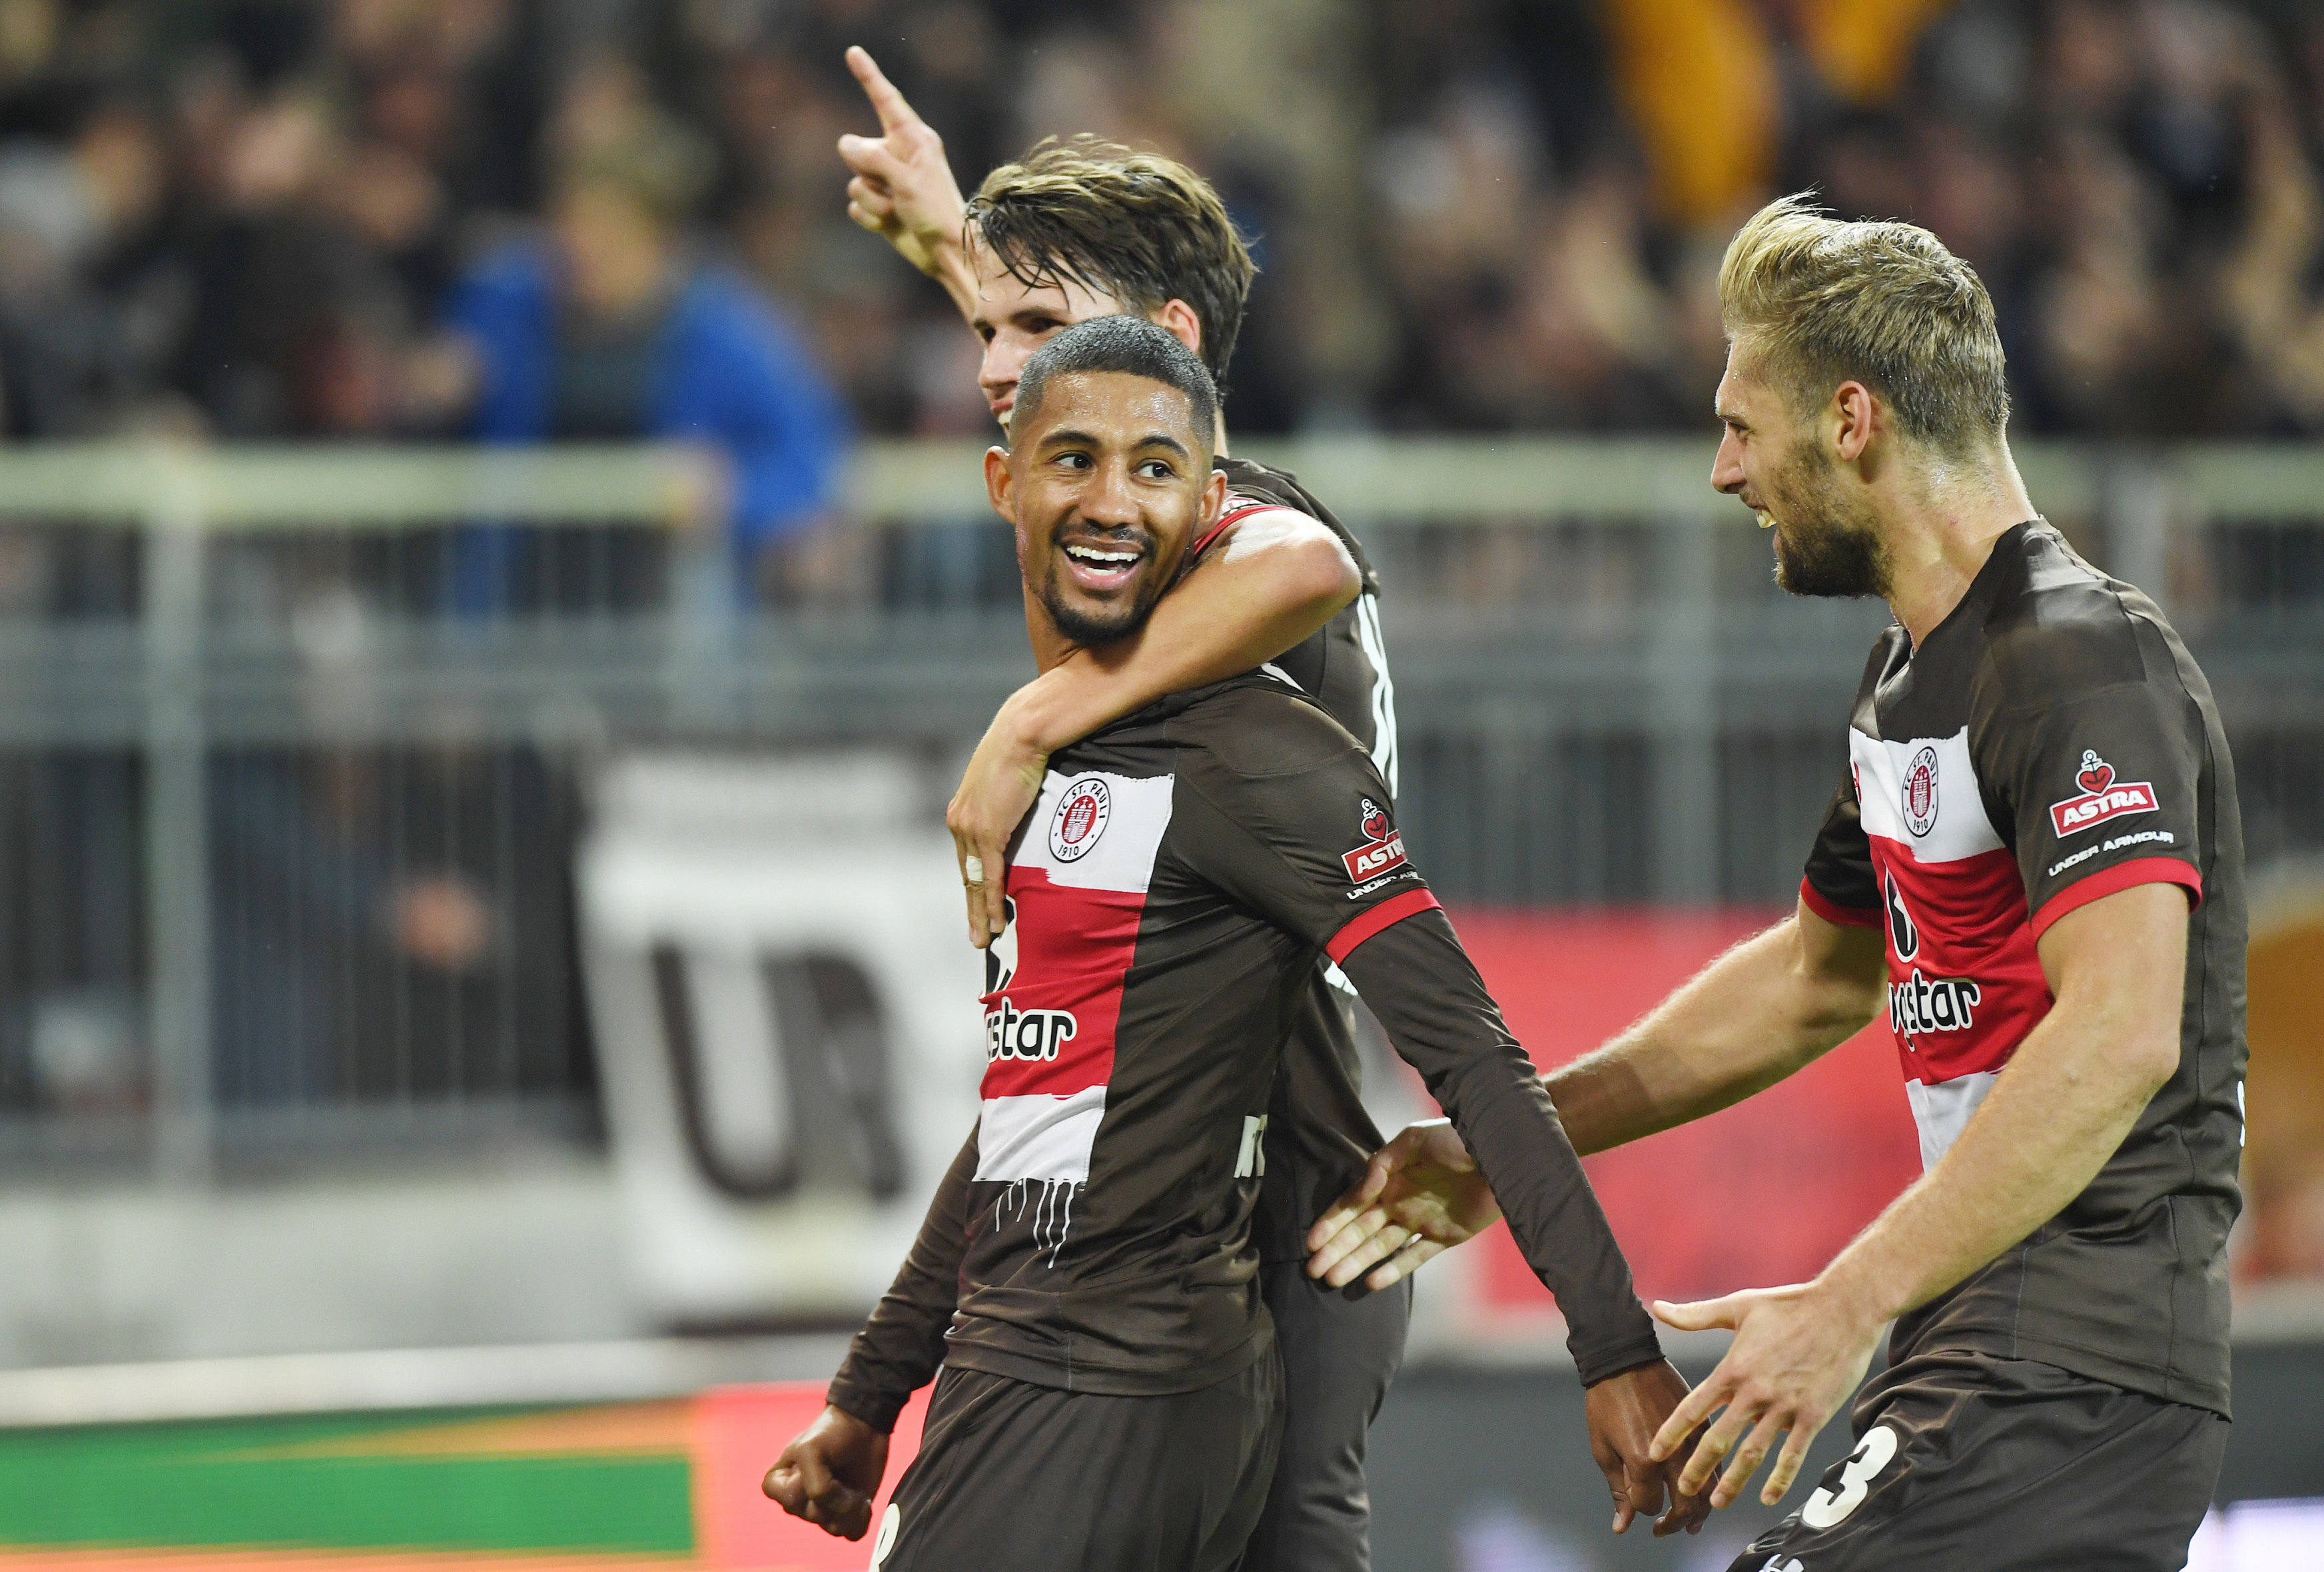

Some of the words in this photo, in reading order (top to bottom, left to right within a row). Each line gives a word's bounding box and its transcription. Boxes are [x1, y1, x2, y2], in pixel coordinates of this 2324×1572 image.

[1904, 773, 1912, 791] FC
[1924, 751, 1936, 787] PAULI
[1058, 801, 1068, 817] FC
[1090, 783, 1107, 819] PAULI
[2063, 790, 2149, 827] ASTRA
[1913, 819, 1928, 832] 1910
[1058, 844, 1079, 858] 1910
[1357, 837, 1405, 875] ASTR
[2048, 845, 2100, 877] UNDER
[2102, 831, 2175, 852] ARMOUR
[1802, 1425, 1898, 1528] 3
